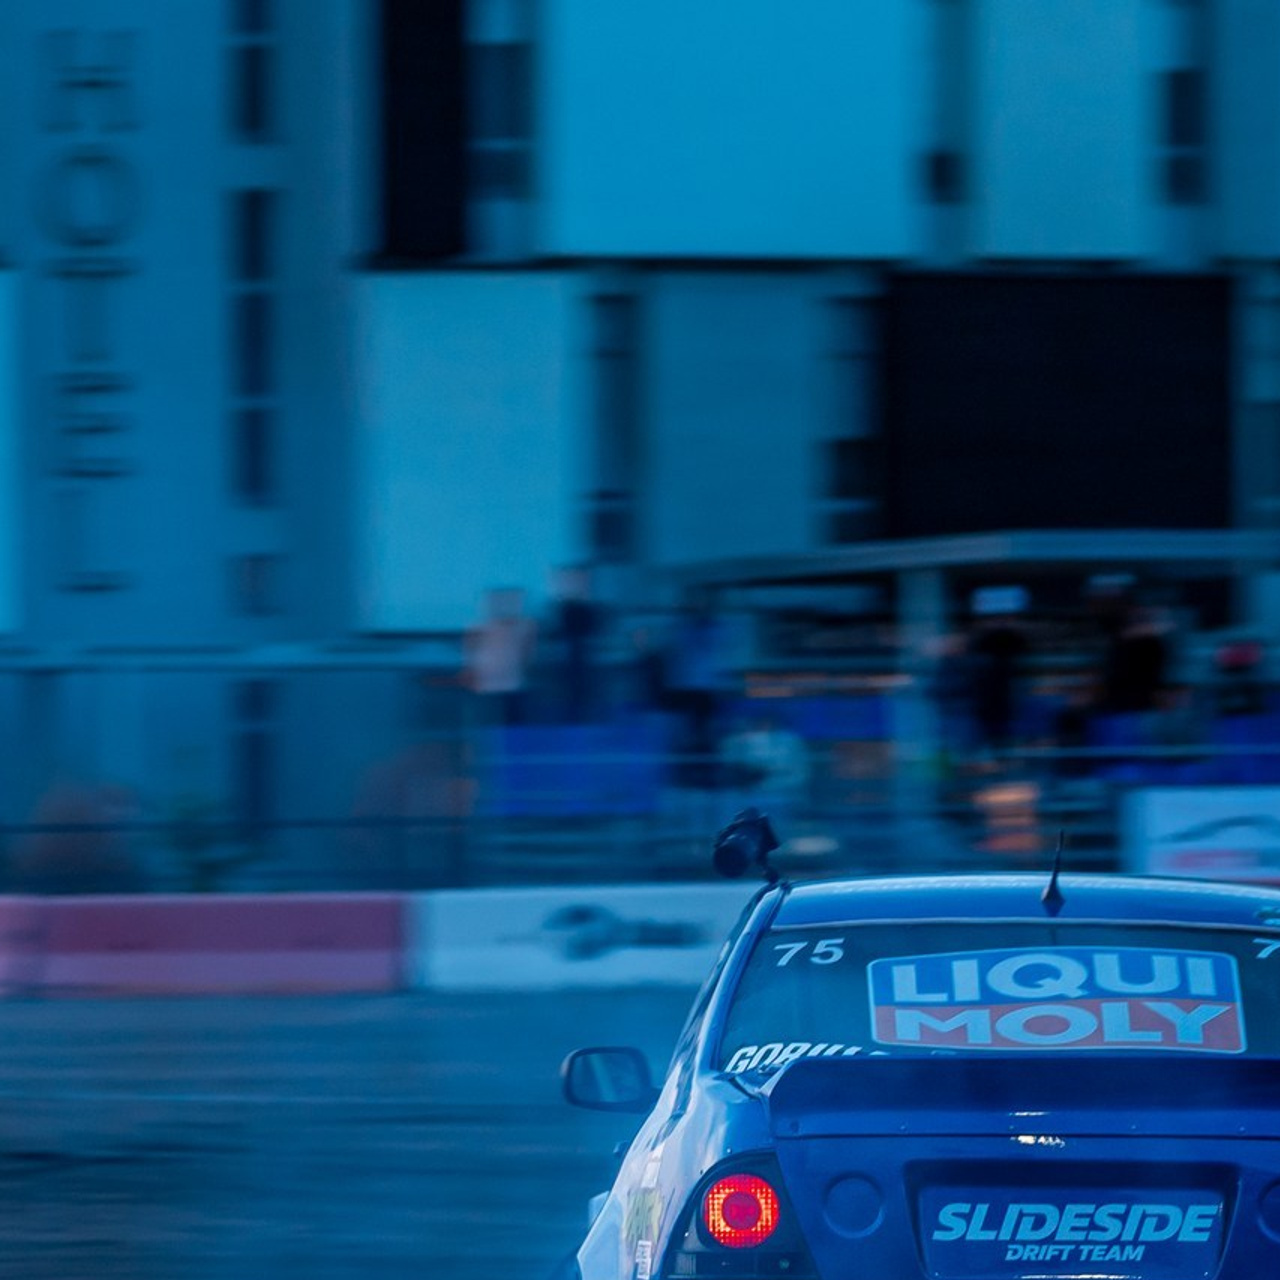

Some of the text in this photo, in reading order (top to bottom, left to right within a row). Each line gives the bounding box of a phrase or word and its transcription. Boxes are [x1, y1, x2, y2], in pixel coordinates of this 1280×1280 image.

[773, 937, 845, 967] 75
[891, 952, 1217, 1002] LIQUI
[894, 1001, 1232, 1045] MOLY
[931, 1202, 1219, 1242] SLIDESIDE
[1004, 1244, 1145, 1262] DRIFT TEAM
